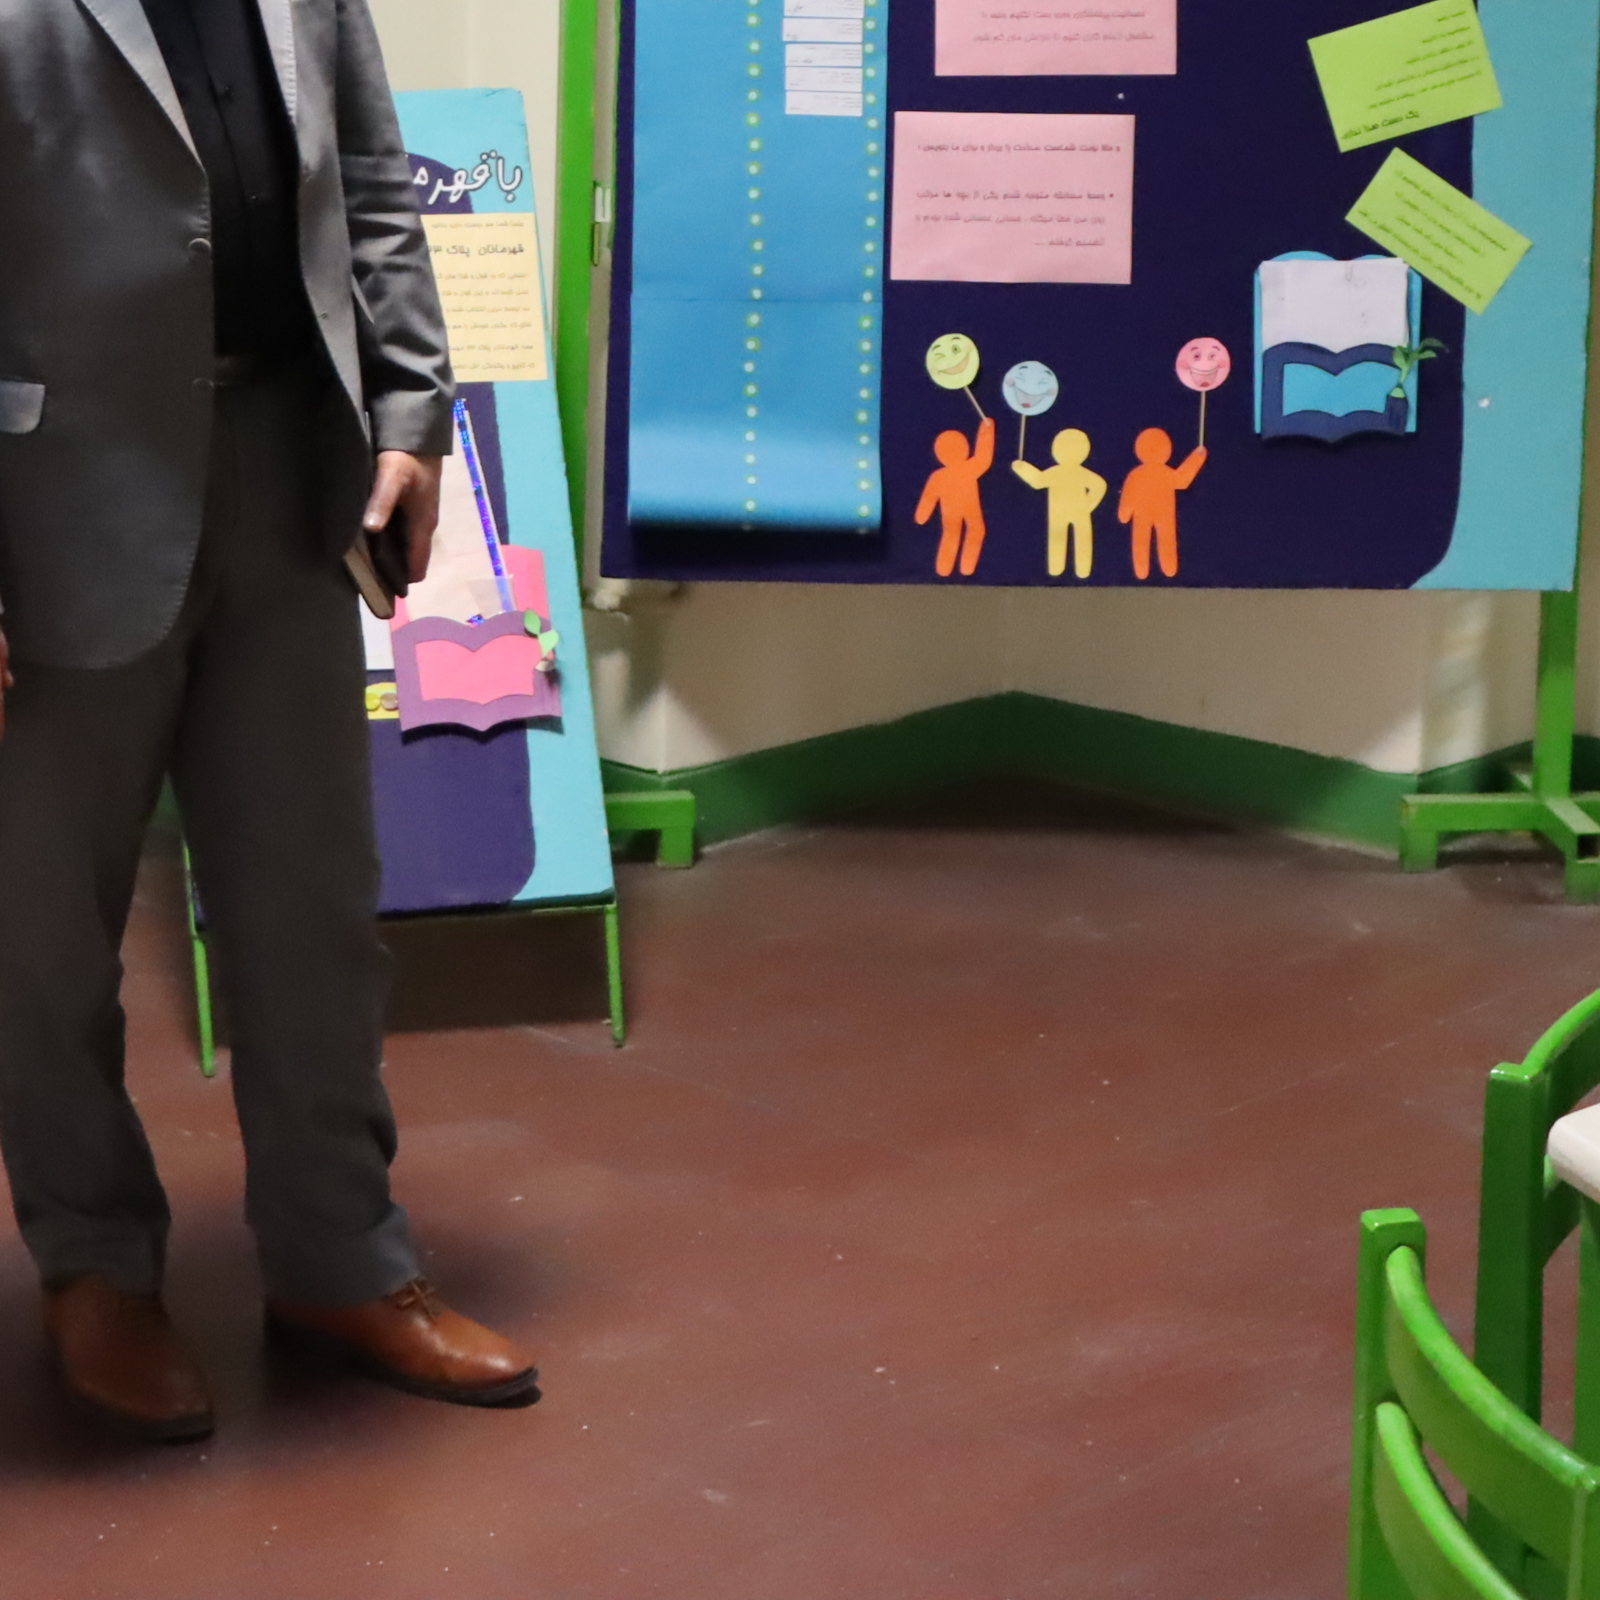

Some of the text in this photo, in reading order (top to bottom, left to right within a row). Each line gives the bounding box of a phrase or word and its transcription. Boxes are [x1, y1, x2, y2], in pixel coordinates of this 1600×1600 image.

[412, 148, 523, 206] با قهرم
[446, 244, 471, 258] پلاک
[477, 243, 525, 256] قهرمانان
